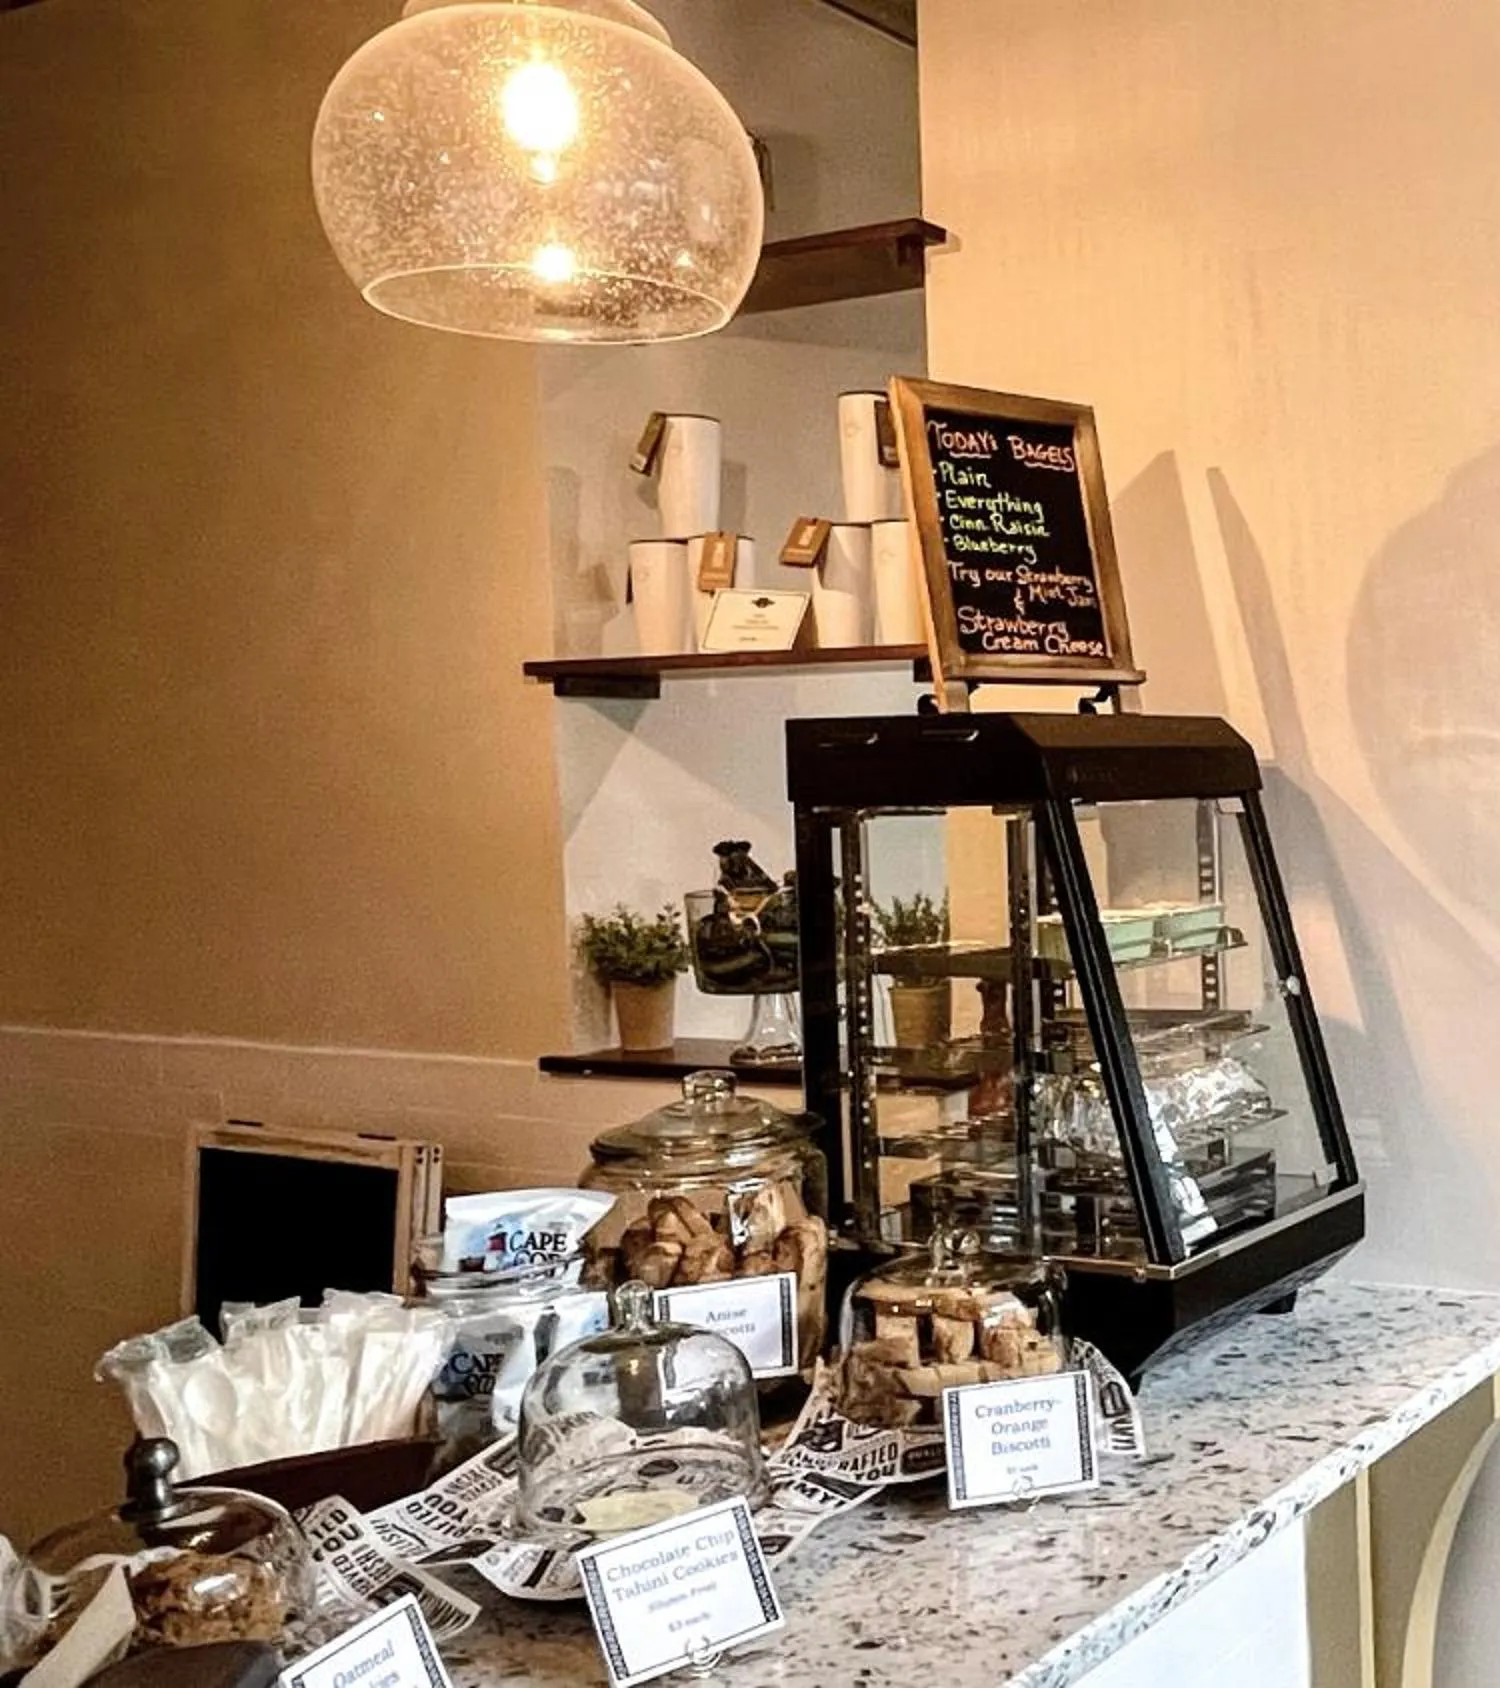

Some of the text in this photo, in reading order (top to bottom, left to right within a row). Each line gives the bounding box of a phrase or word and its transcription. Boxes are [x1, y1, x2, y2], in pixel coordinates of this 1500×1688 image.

[939, 461, 992, 488] Plain
[945, 489, 1044, 523] Everything
[990, 512, 1050, 537] Raisin
[952, 534, 1037, 565] Blueberry
[948, 561, 981, 588] Try
[985, 568, 1013, 582] our
[957, 605, 1069, 642] Strawberry
[982, 631, 1039, 651] Cream
[509, 1230, 567, 1252] CAPE
[991, 1418, 1049, 1436] Orange
[991, 1436, 1051, 1456] Biscotti
[606, 1527, 736, 1584] Chocolate Chip
[611, 1551, 739, 1603] Tahini Cookies
